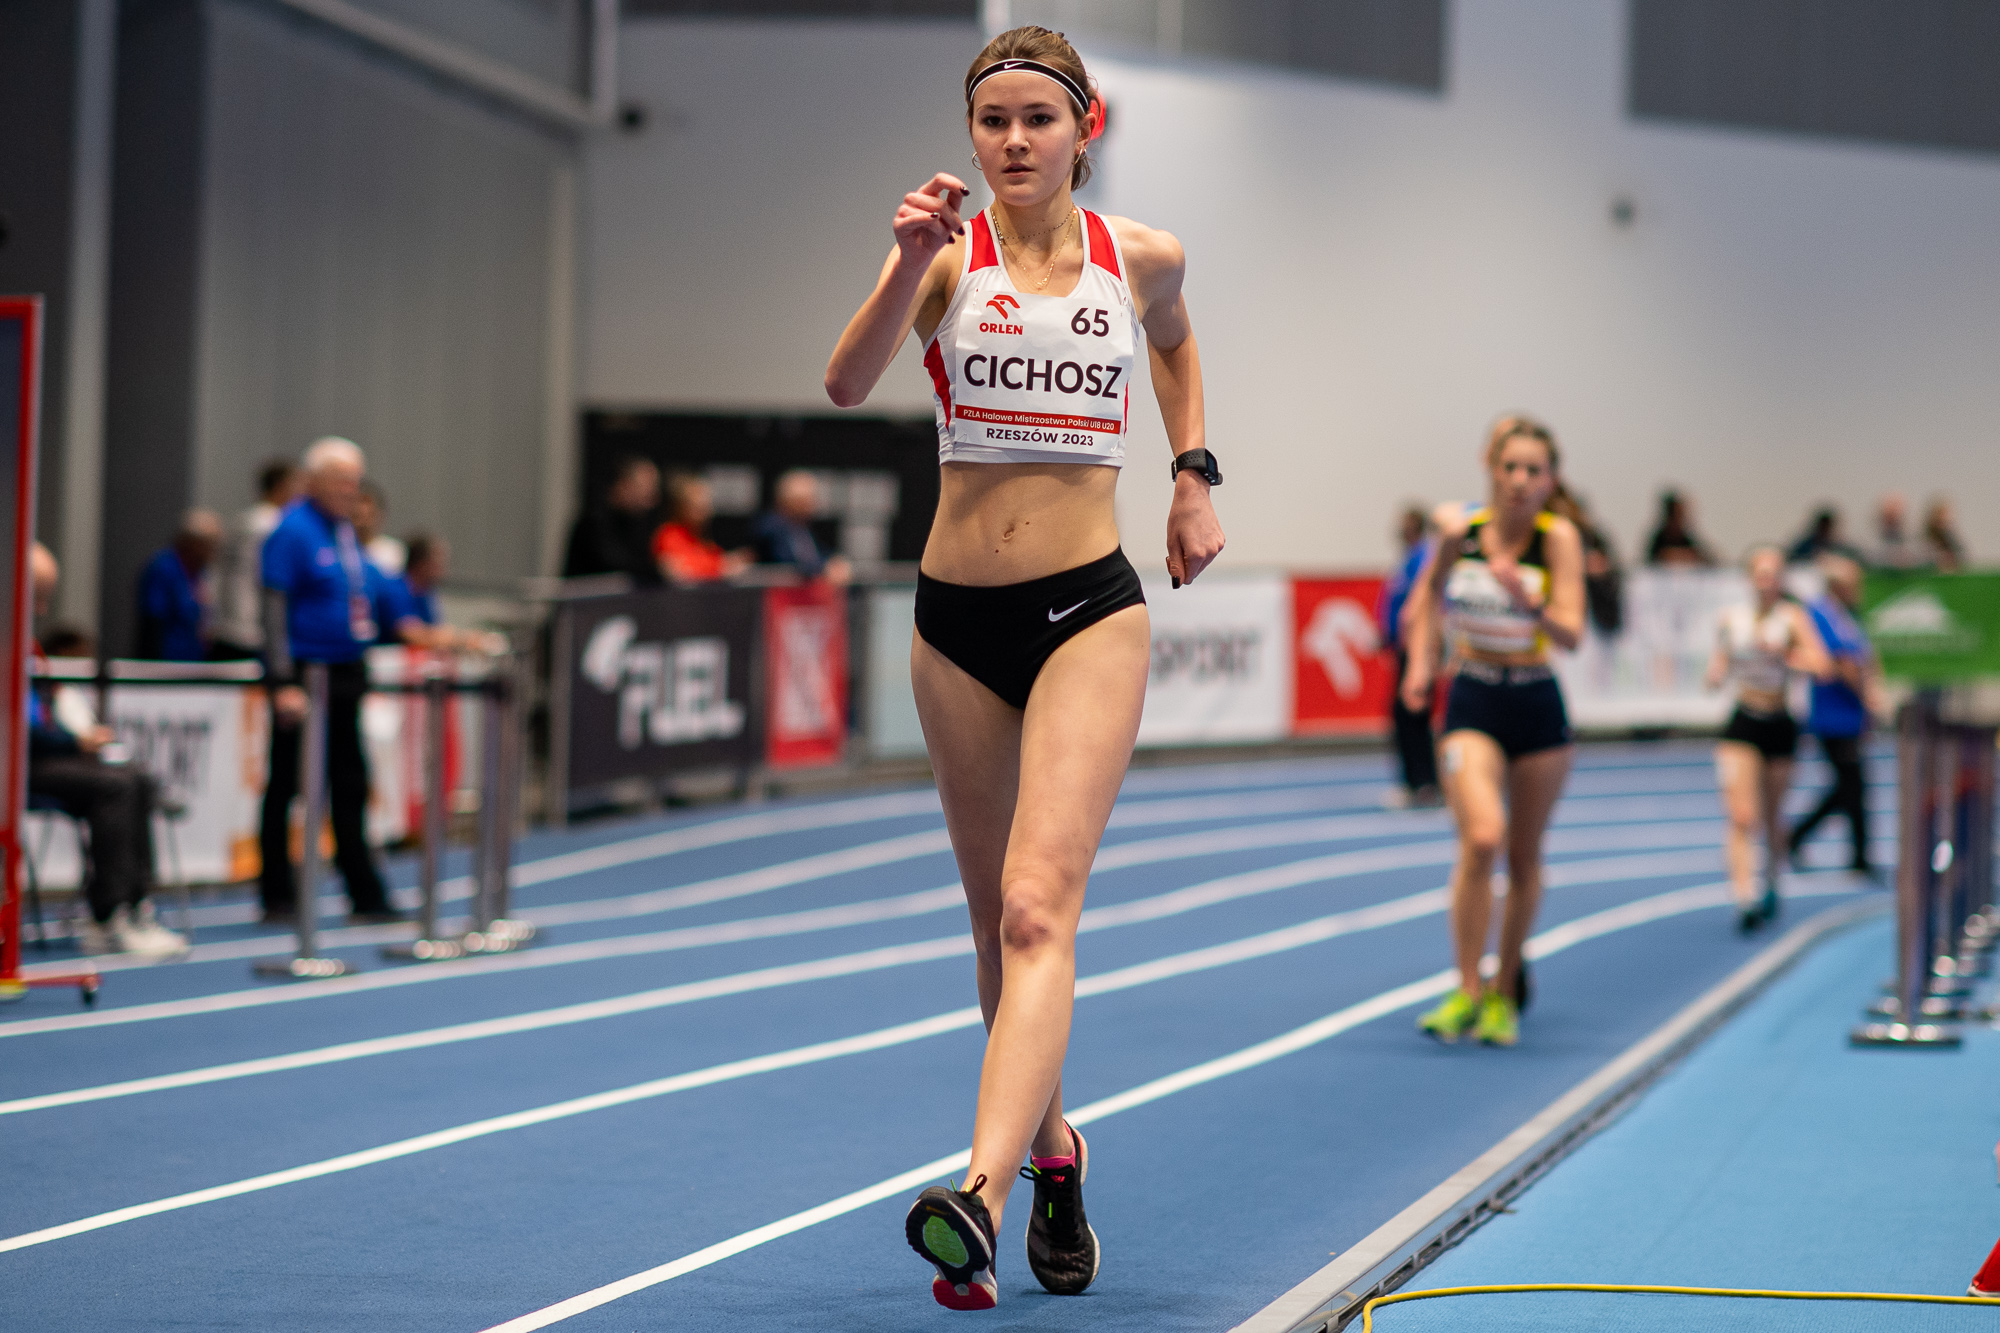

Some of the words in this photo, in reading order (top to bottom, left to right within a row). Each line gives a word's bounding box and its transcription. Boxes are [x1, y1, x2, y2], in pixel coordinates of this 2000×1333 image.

[979, 322, 1023, 335] ORLEN
[1071, 307, 1110, 337] 65
[964, 354, 1123, 399] CICHOSZ
[963, 409, 981, 419] PZLA
[982, 412, 1013, 422] Halowe
[1014, 414, 1066, 426] Mistrzostwa
[1067, 418, 1090, 428] Polski
[1102, 421, 1115, 431] U20
[986, 428, 1058, 444] RZESZÓW
[1062, 433, 1094, 446] 2023
